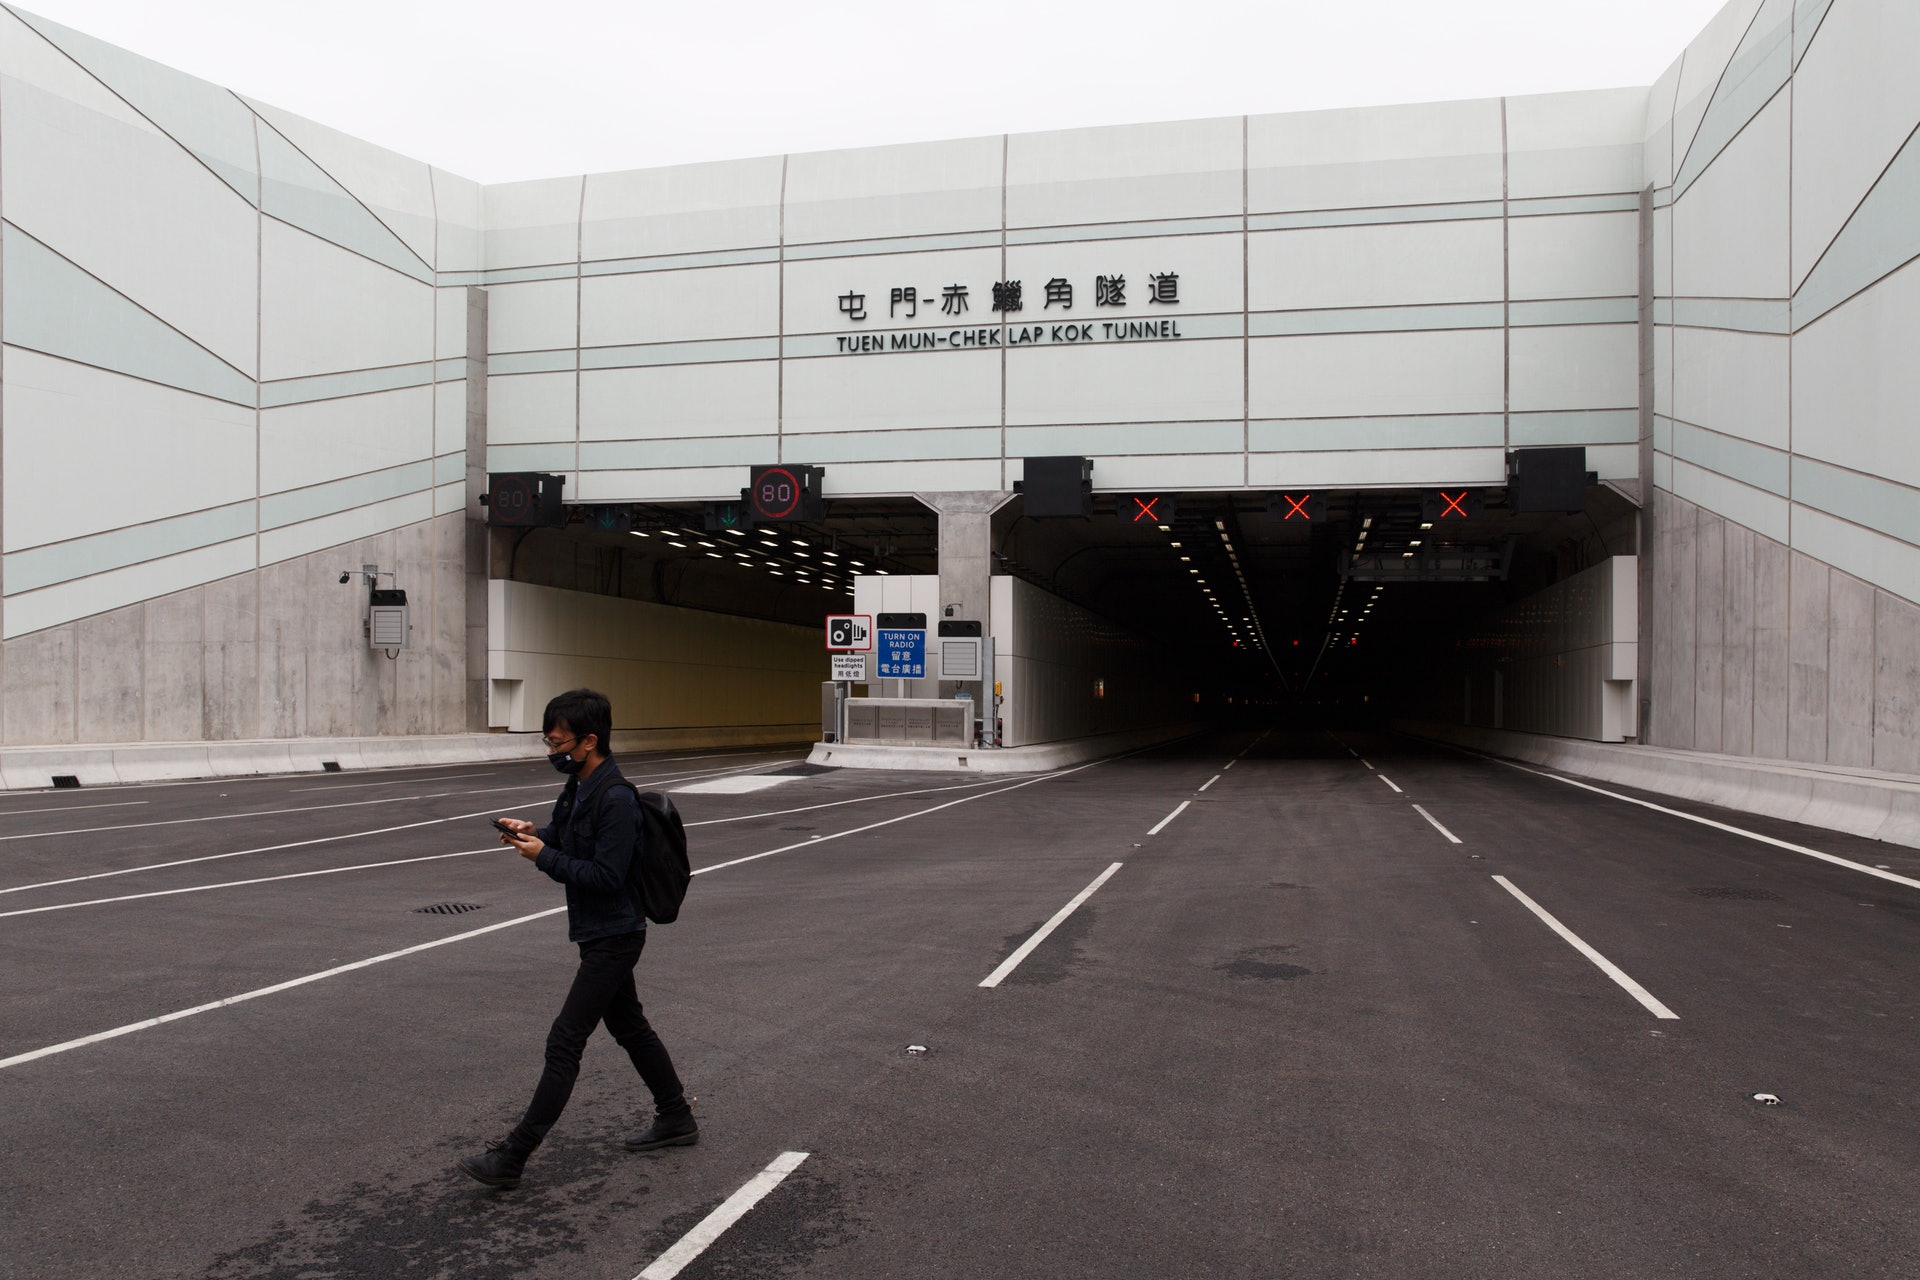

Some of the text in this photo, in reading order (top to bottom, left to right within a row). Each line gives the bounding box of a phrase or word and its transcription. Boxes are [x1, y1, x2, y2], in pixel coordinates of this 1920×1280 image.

[837, 320, 1182, 352] TUEN MUN-CHEK LAP KOK TUNNEL
[498, 490, 524, 508] 80
[762, 483, 791, 502] 80
[891, 651, 912, 662] 留意
[880, 663, 922, 675] 電台廣播
